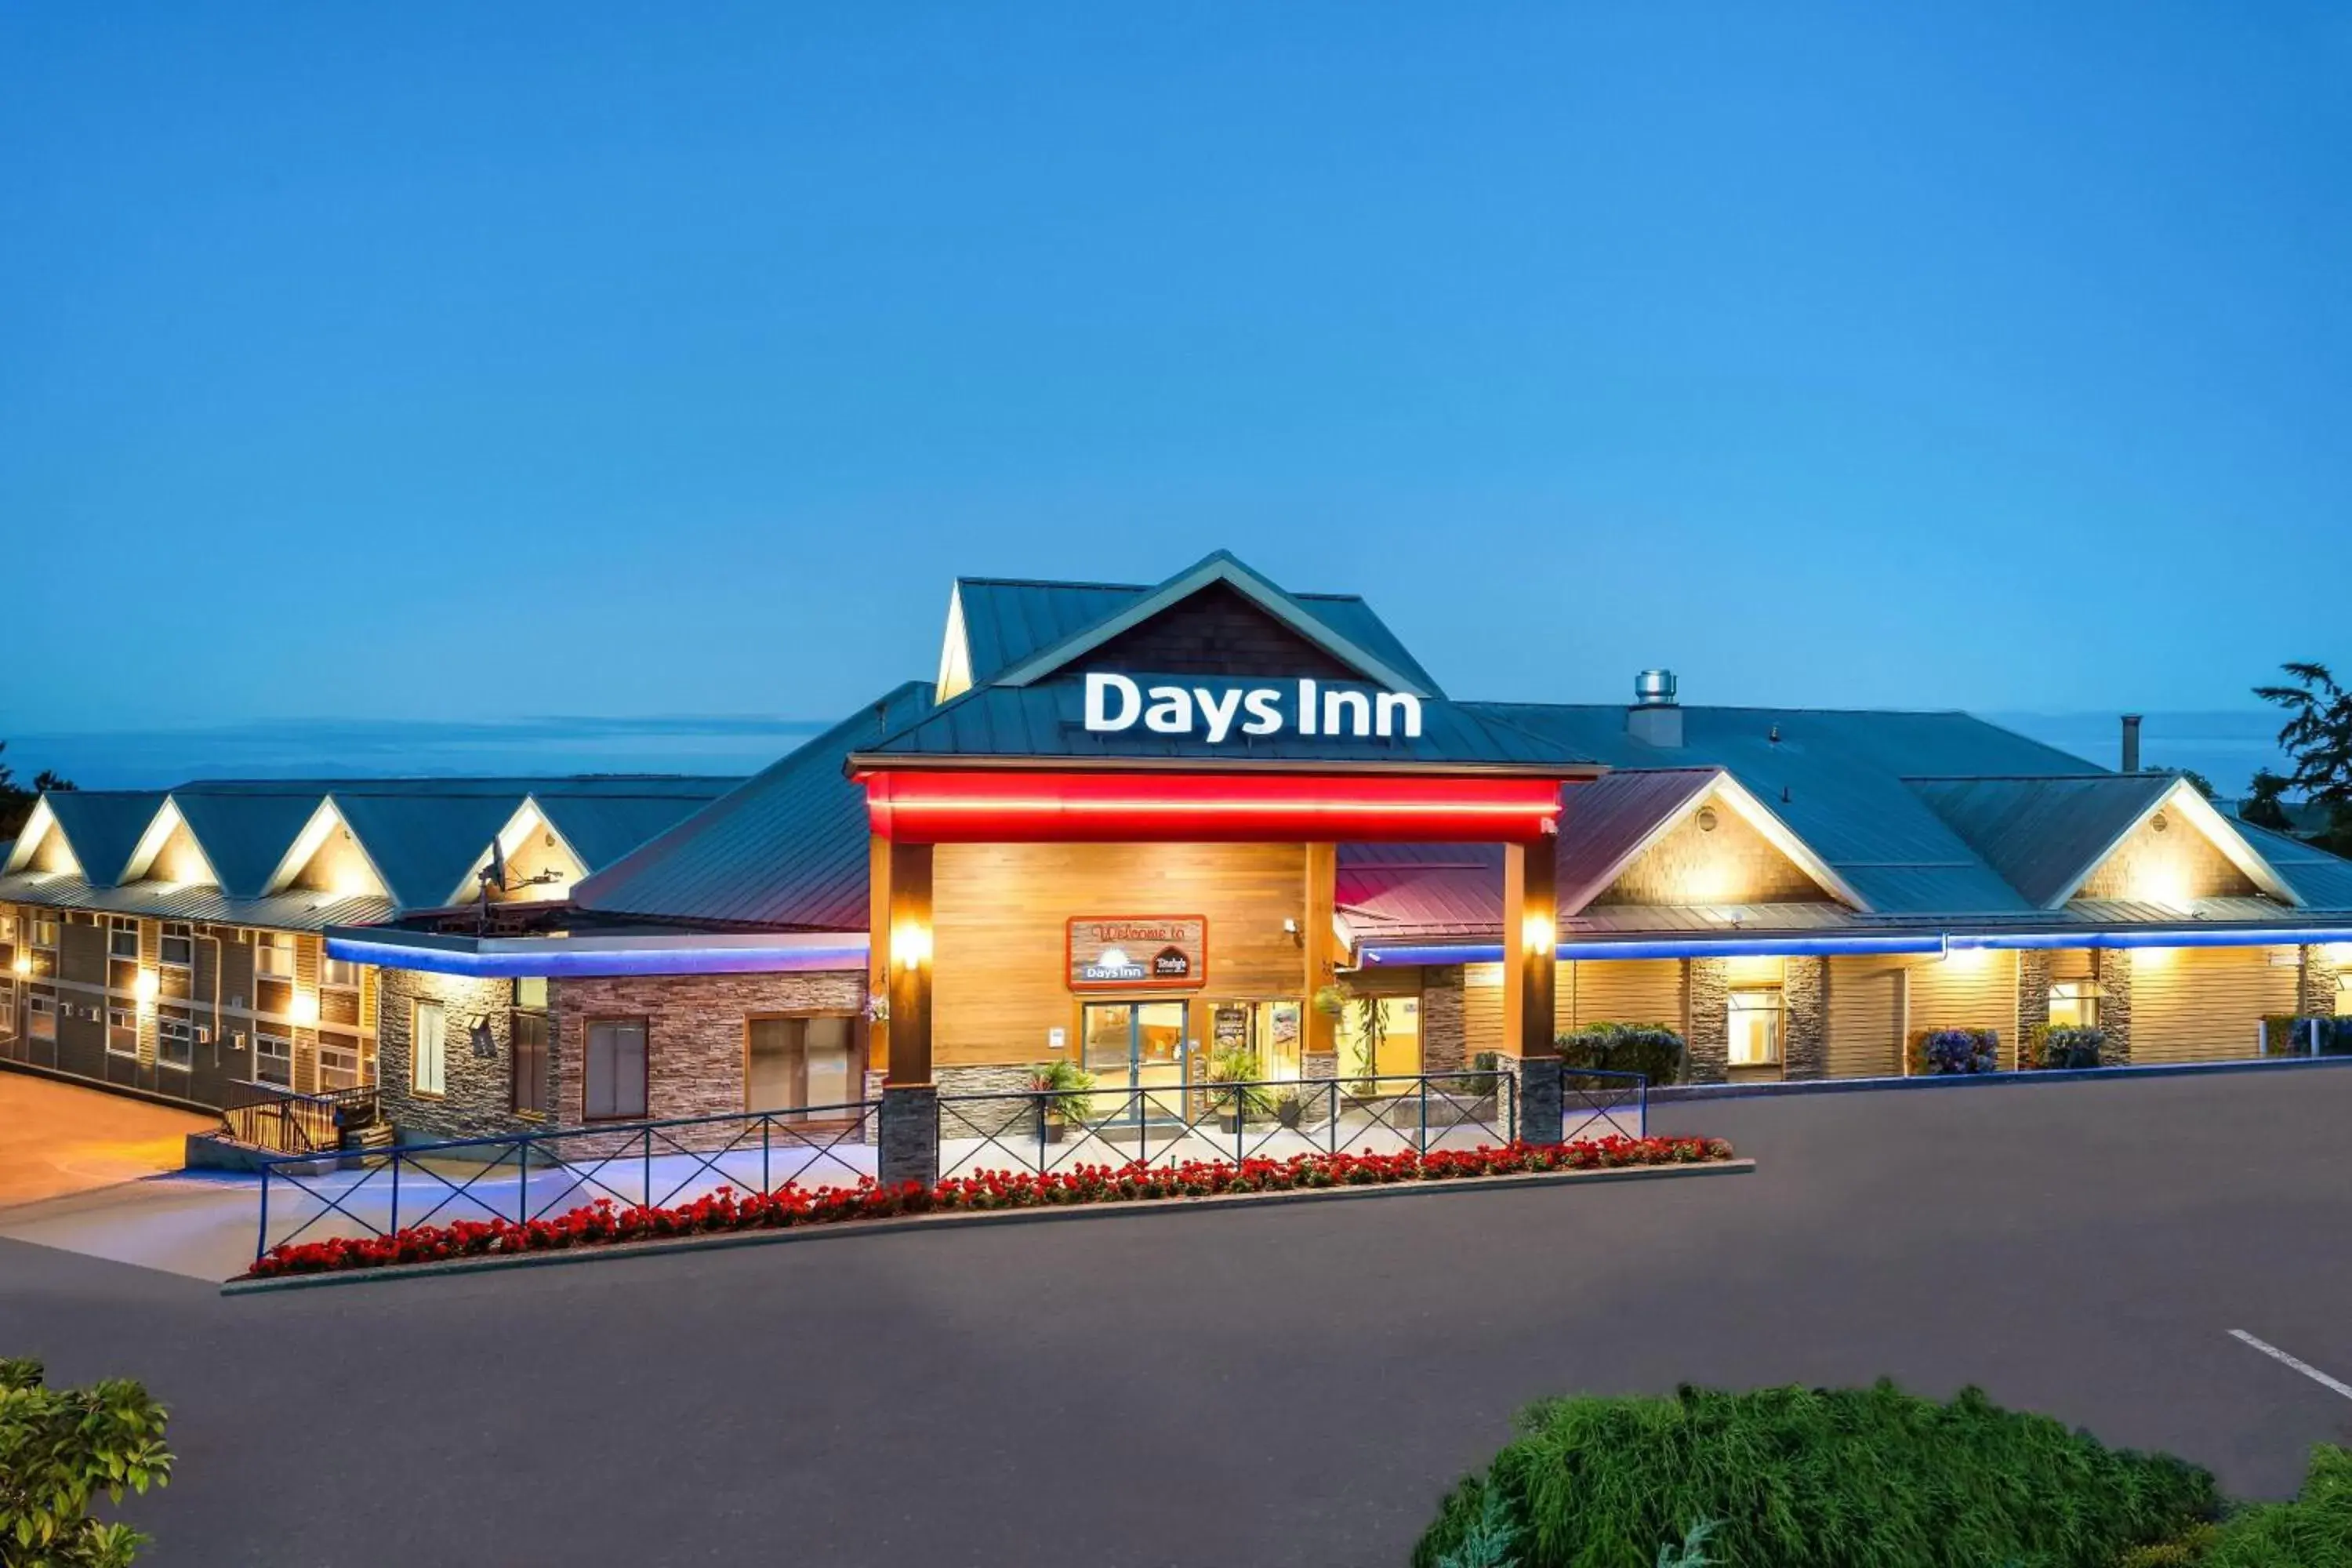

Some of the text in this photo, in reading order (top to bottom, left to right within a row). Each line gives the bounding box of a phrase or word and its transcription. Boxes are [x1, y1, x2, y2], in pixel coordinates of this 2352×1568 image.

[1084, 672, 1422, 743] Days Inn
[1092, 924, 1185, 942] Welcome to
[1087, 965, 1142, 978] Days Inn
